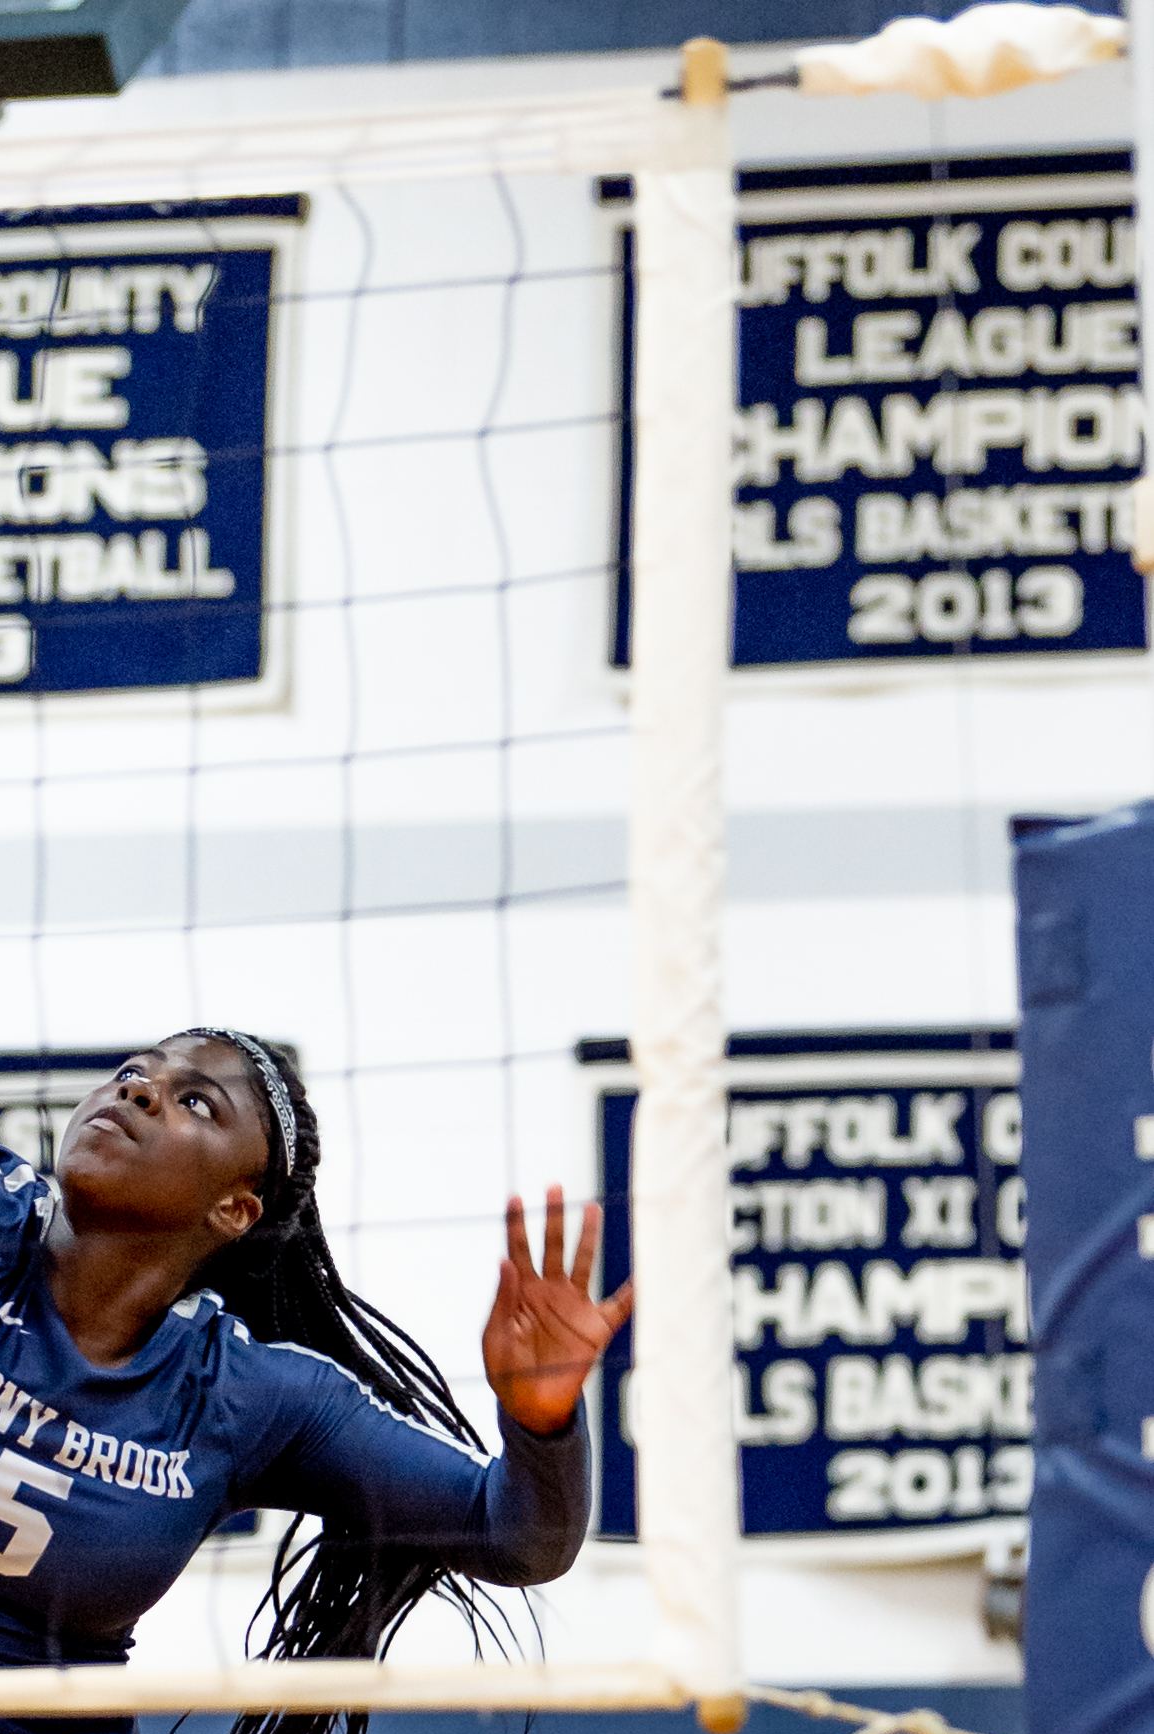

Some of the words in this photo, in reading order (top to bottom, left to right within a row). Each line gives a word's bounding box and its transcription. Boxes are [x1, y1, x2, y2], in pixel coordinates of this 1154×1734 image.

[795, 301, 1141, 387] LEAGUE
[849, 566, 1084, 643] 2013
[53, 1420, 195, 1499] BROOK
